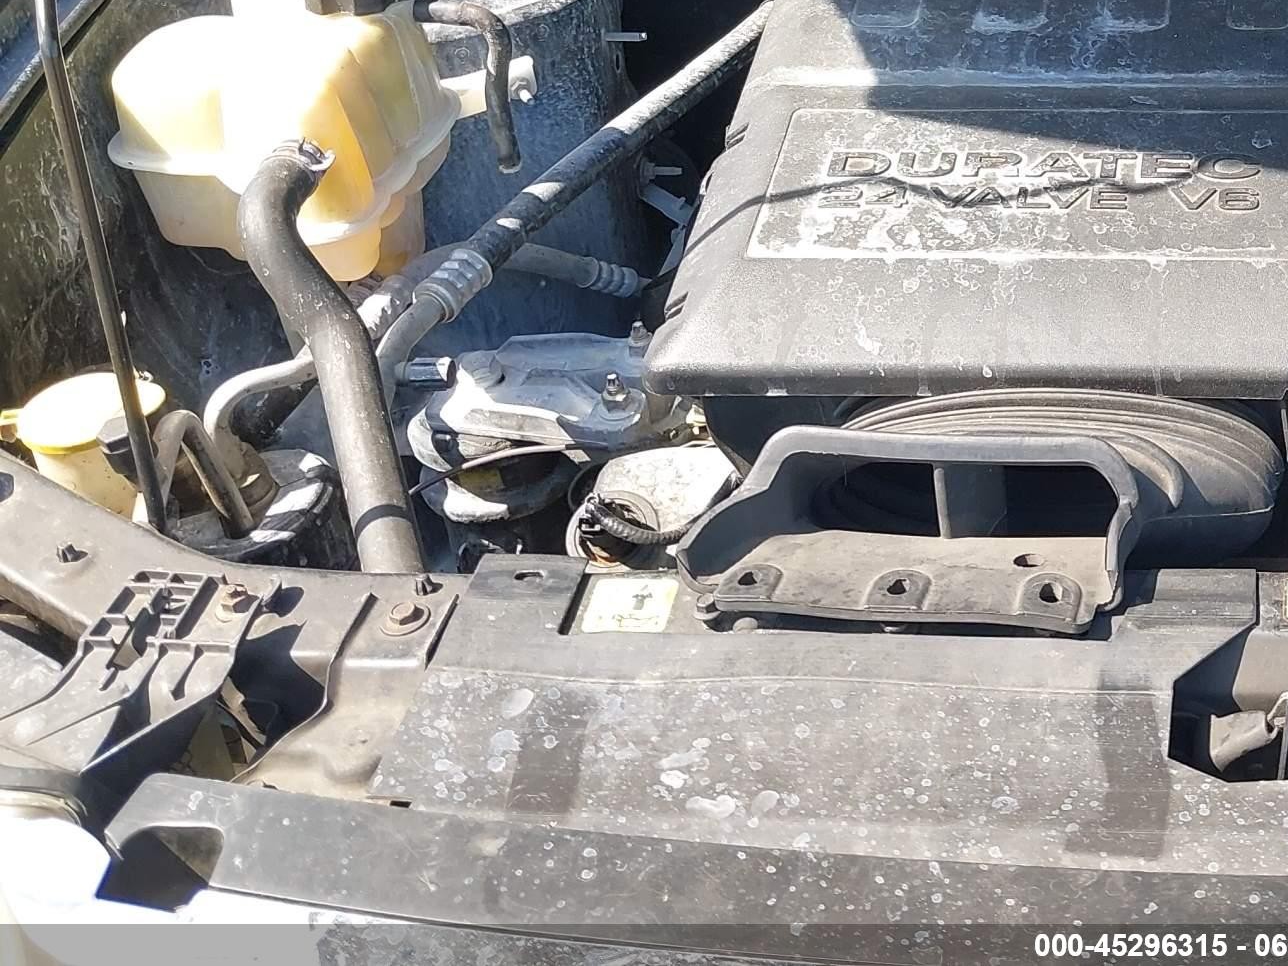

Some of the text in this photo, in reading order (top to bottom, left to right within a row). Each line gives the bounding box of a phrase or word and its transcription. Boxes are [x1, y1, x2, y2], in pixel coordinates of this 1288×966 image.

[826, 150, 1262, 180] DURATEC
[818, 185, 1262, 212] 24 VALVE V6
